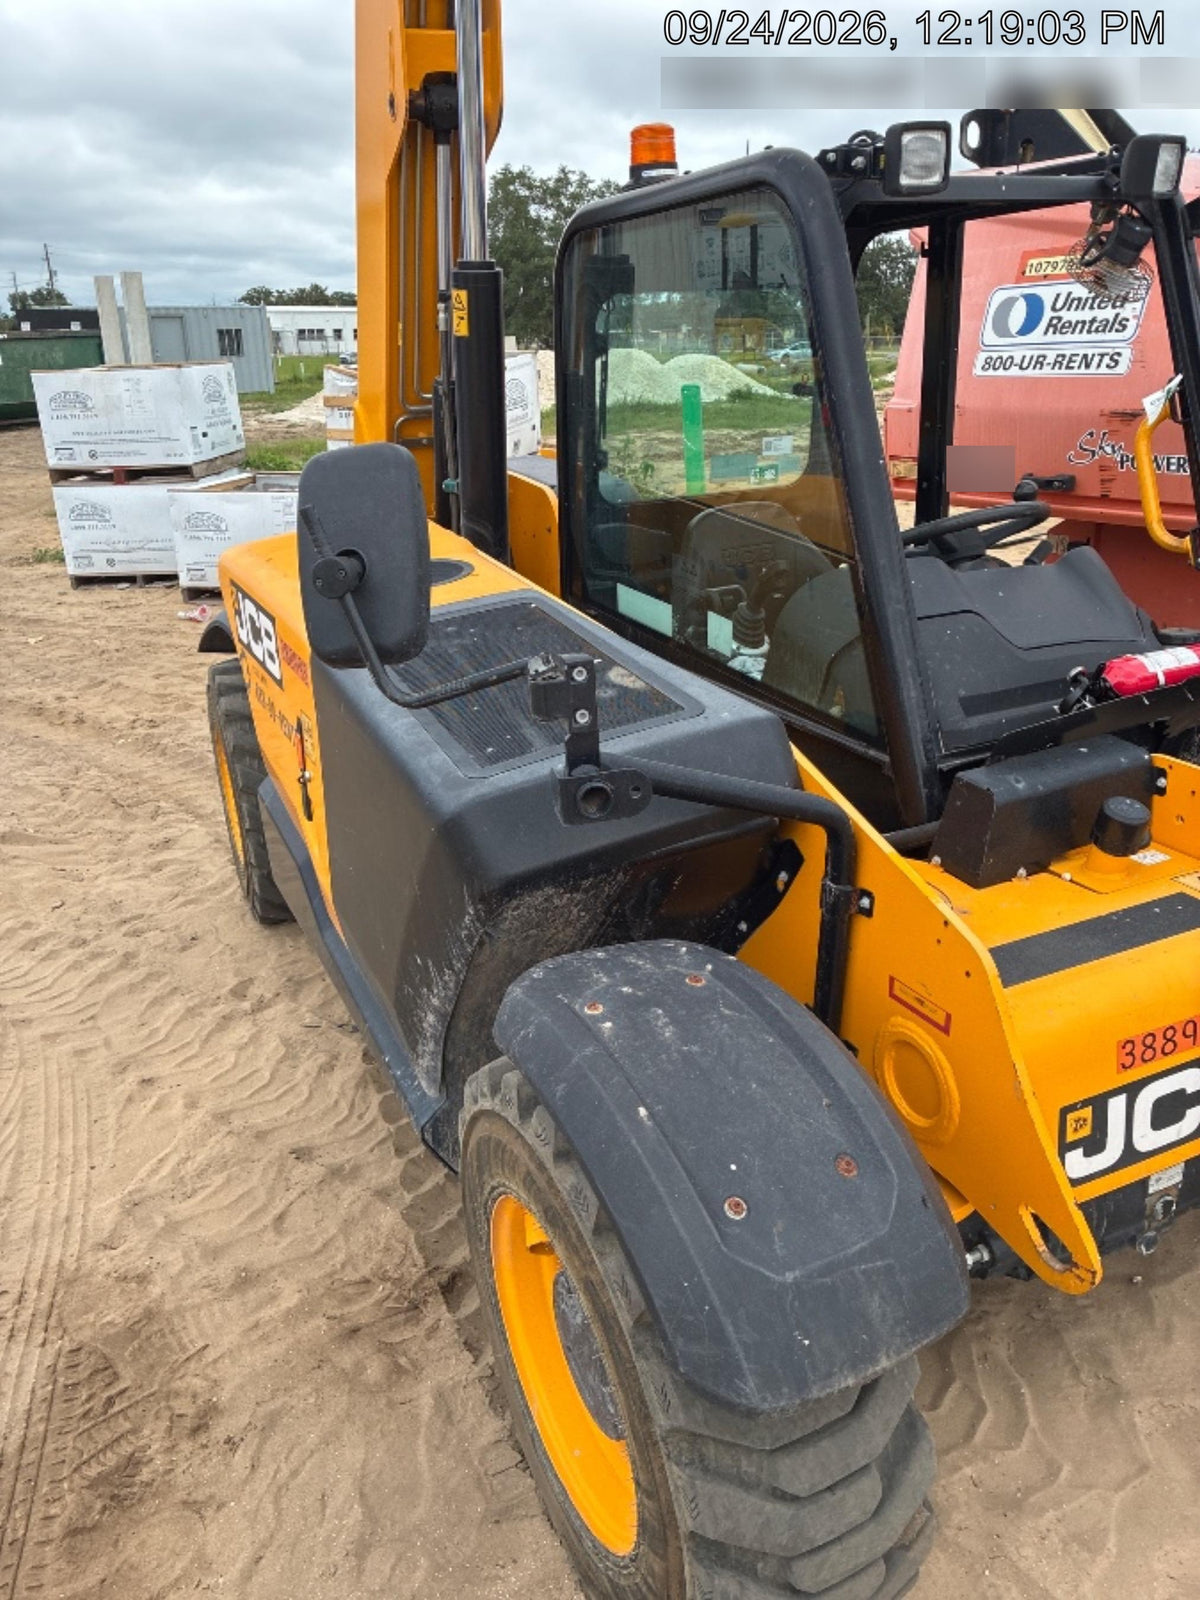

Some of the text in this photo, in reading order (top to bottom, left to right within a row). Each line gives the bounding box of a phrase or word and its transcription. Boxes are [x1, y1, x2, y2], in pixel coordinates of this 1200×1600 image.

[1050, 291, 1127, 313] United
[1043, 312, 1130, 336] Rentals
[981, 351, 1122, 372] 800-UR-RENTS
[1067, 430, 1124, 465] Sky
[236, 591, 281, 680] JCB
